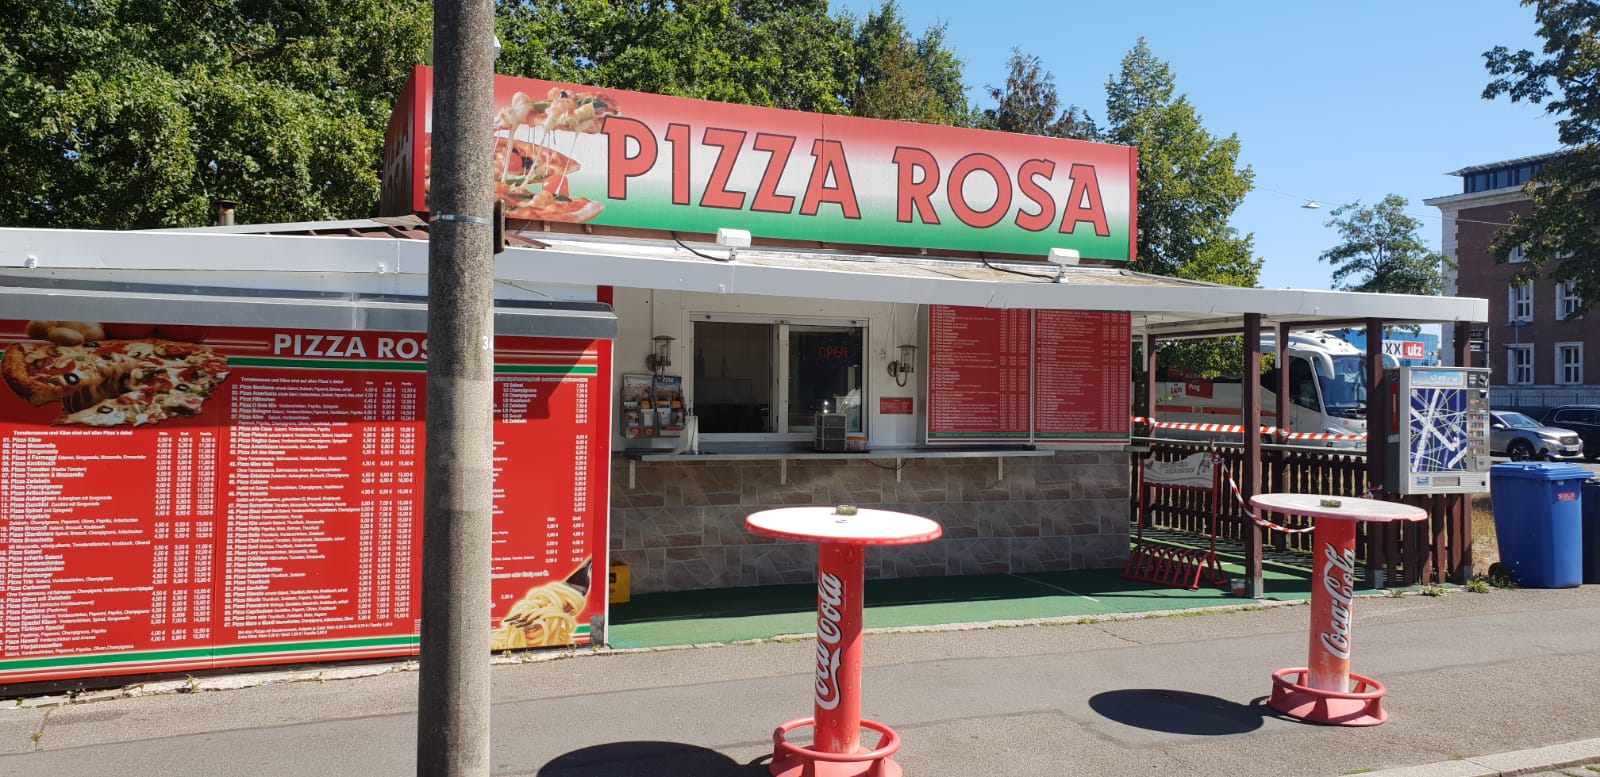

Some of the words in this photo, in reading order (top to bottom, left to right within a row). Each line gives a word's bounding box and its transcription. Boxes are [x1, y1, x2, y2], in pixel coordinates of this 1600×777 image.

[601, 117, 862, 220] PIZZA
[892, 146, 1110, 238] ROSA
[274, 333, 367, 358] PIZZA
[818, 345, 848, 360] OPEN
